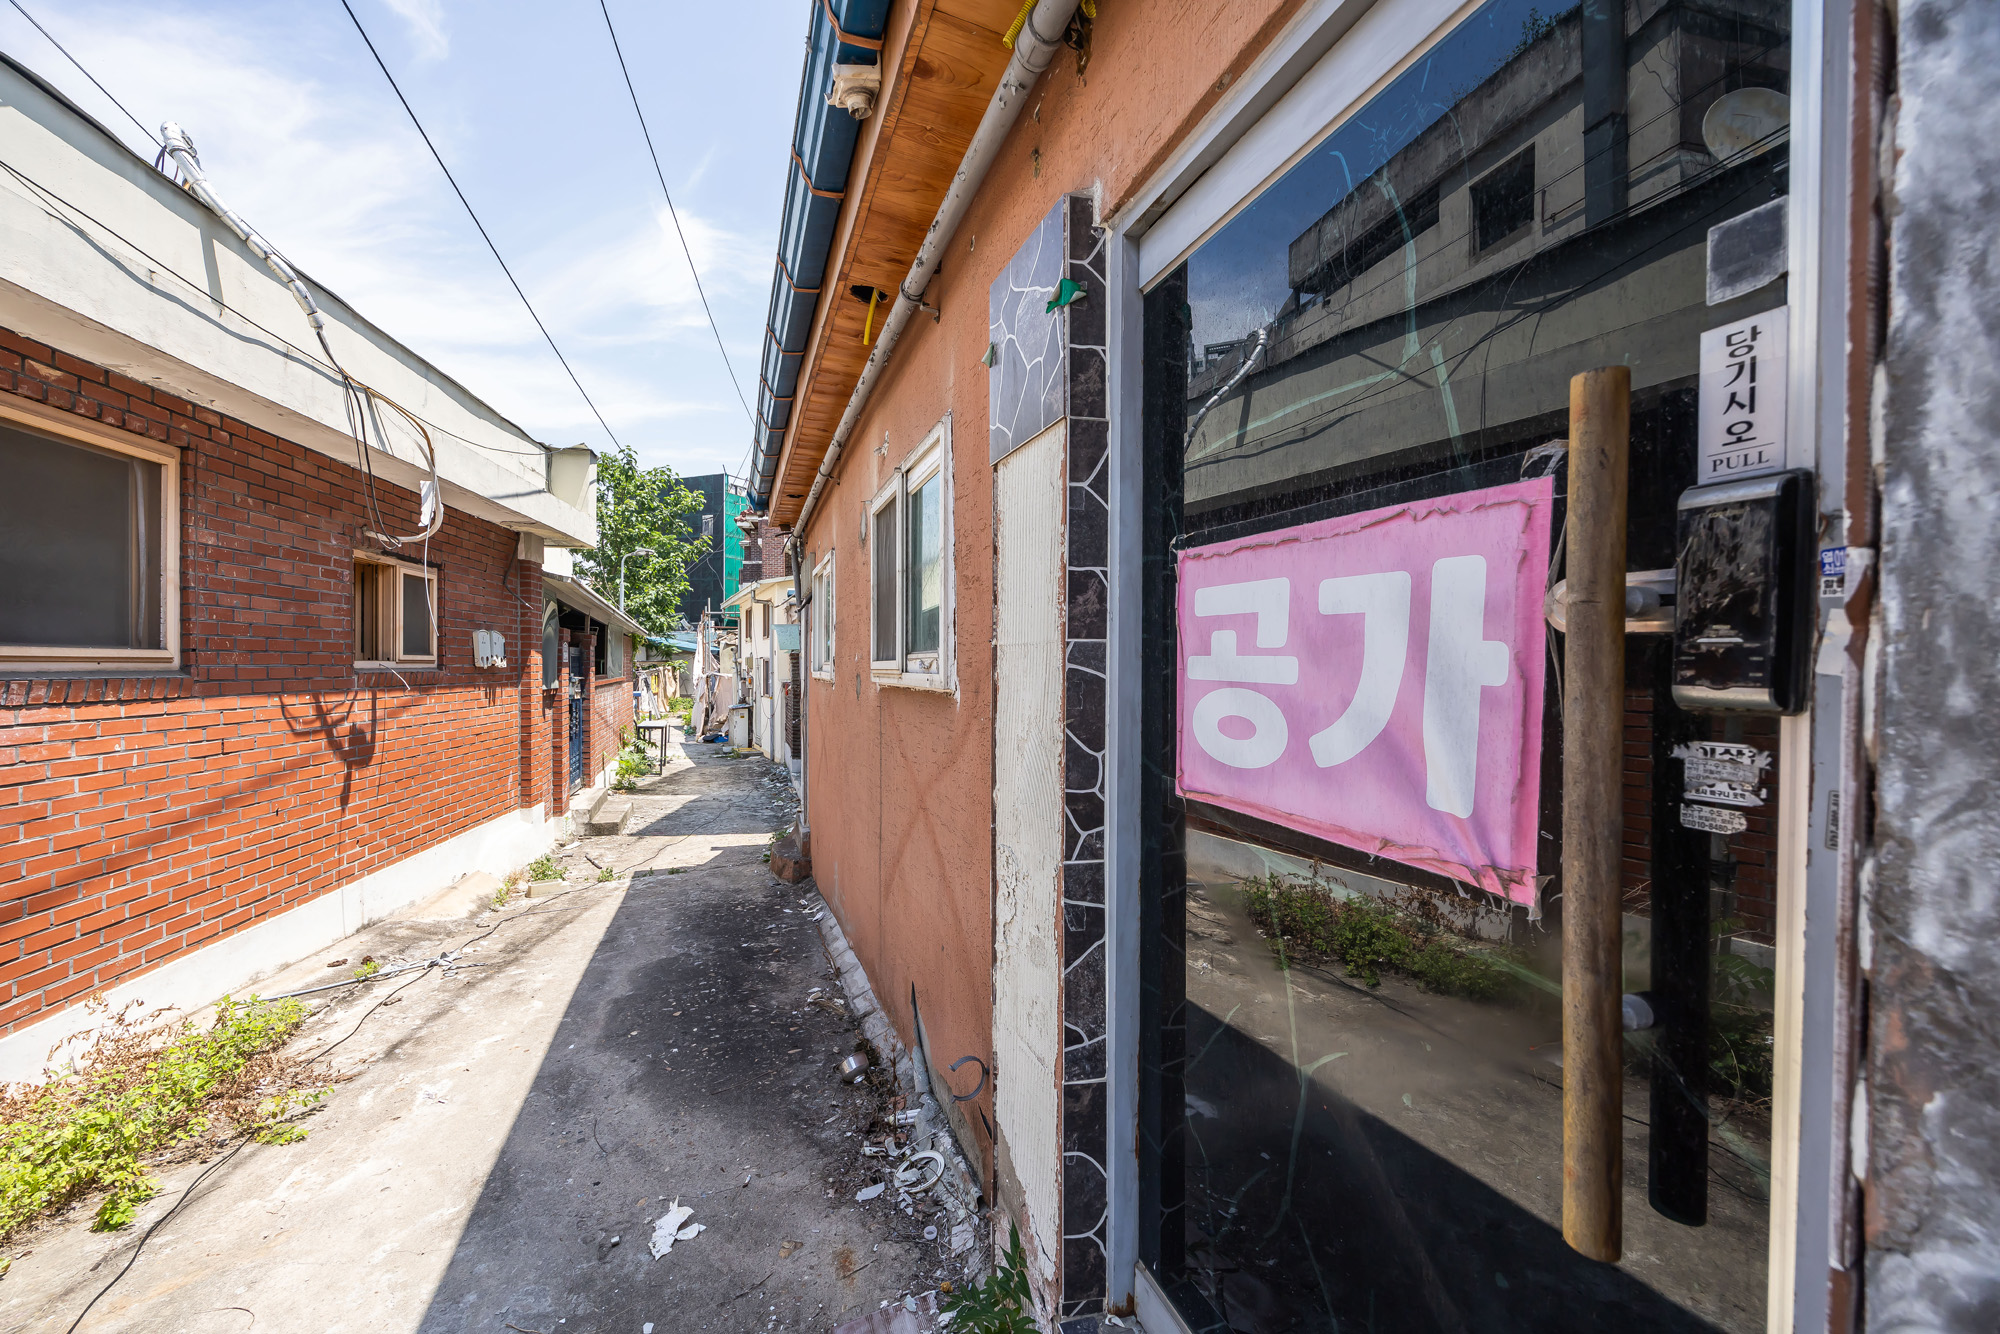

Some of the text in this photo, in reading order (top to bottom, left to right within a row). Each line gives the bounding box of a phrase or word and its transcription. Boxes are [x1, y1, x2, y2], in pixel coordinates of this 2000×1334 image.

[1722, 325, 1762, 447] 당기시오
[1711, 450, 1770, 473] PULL
[1187, 554, 1510, 819] 공가
